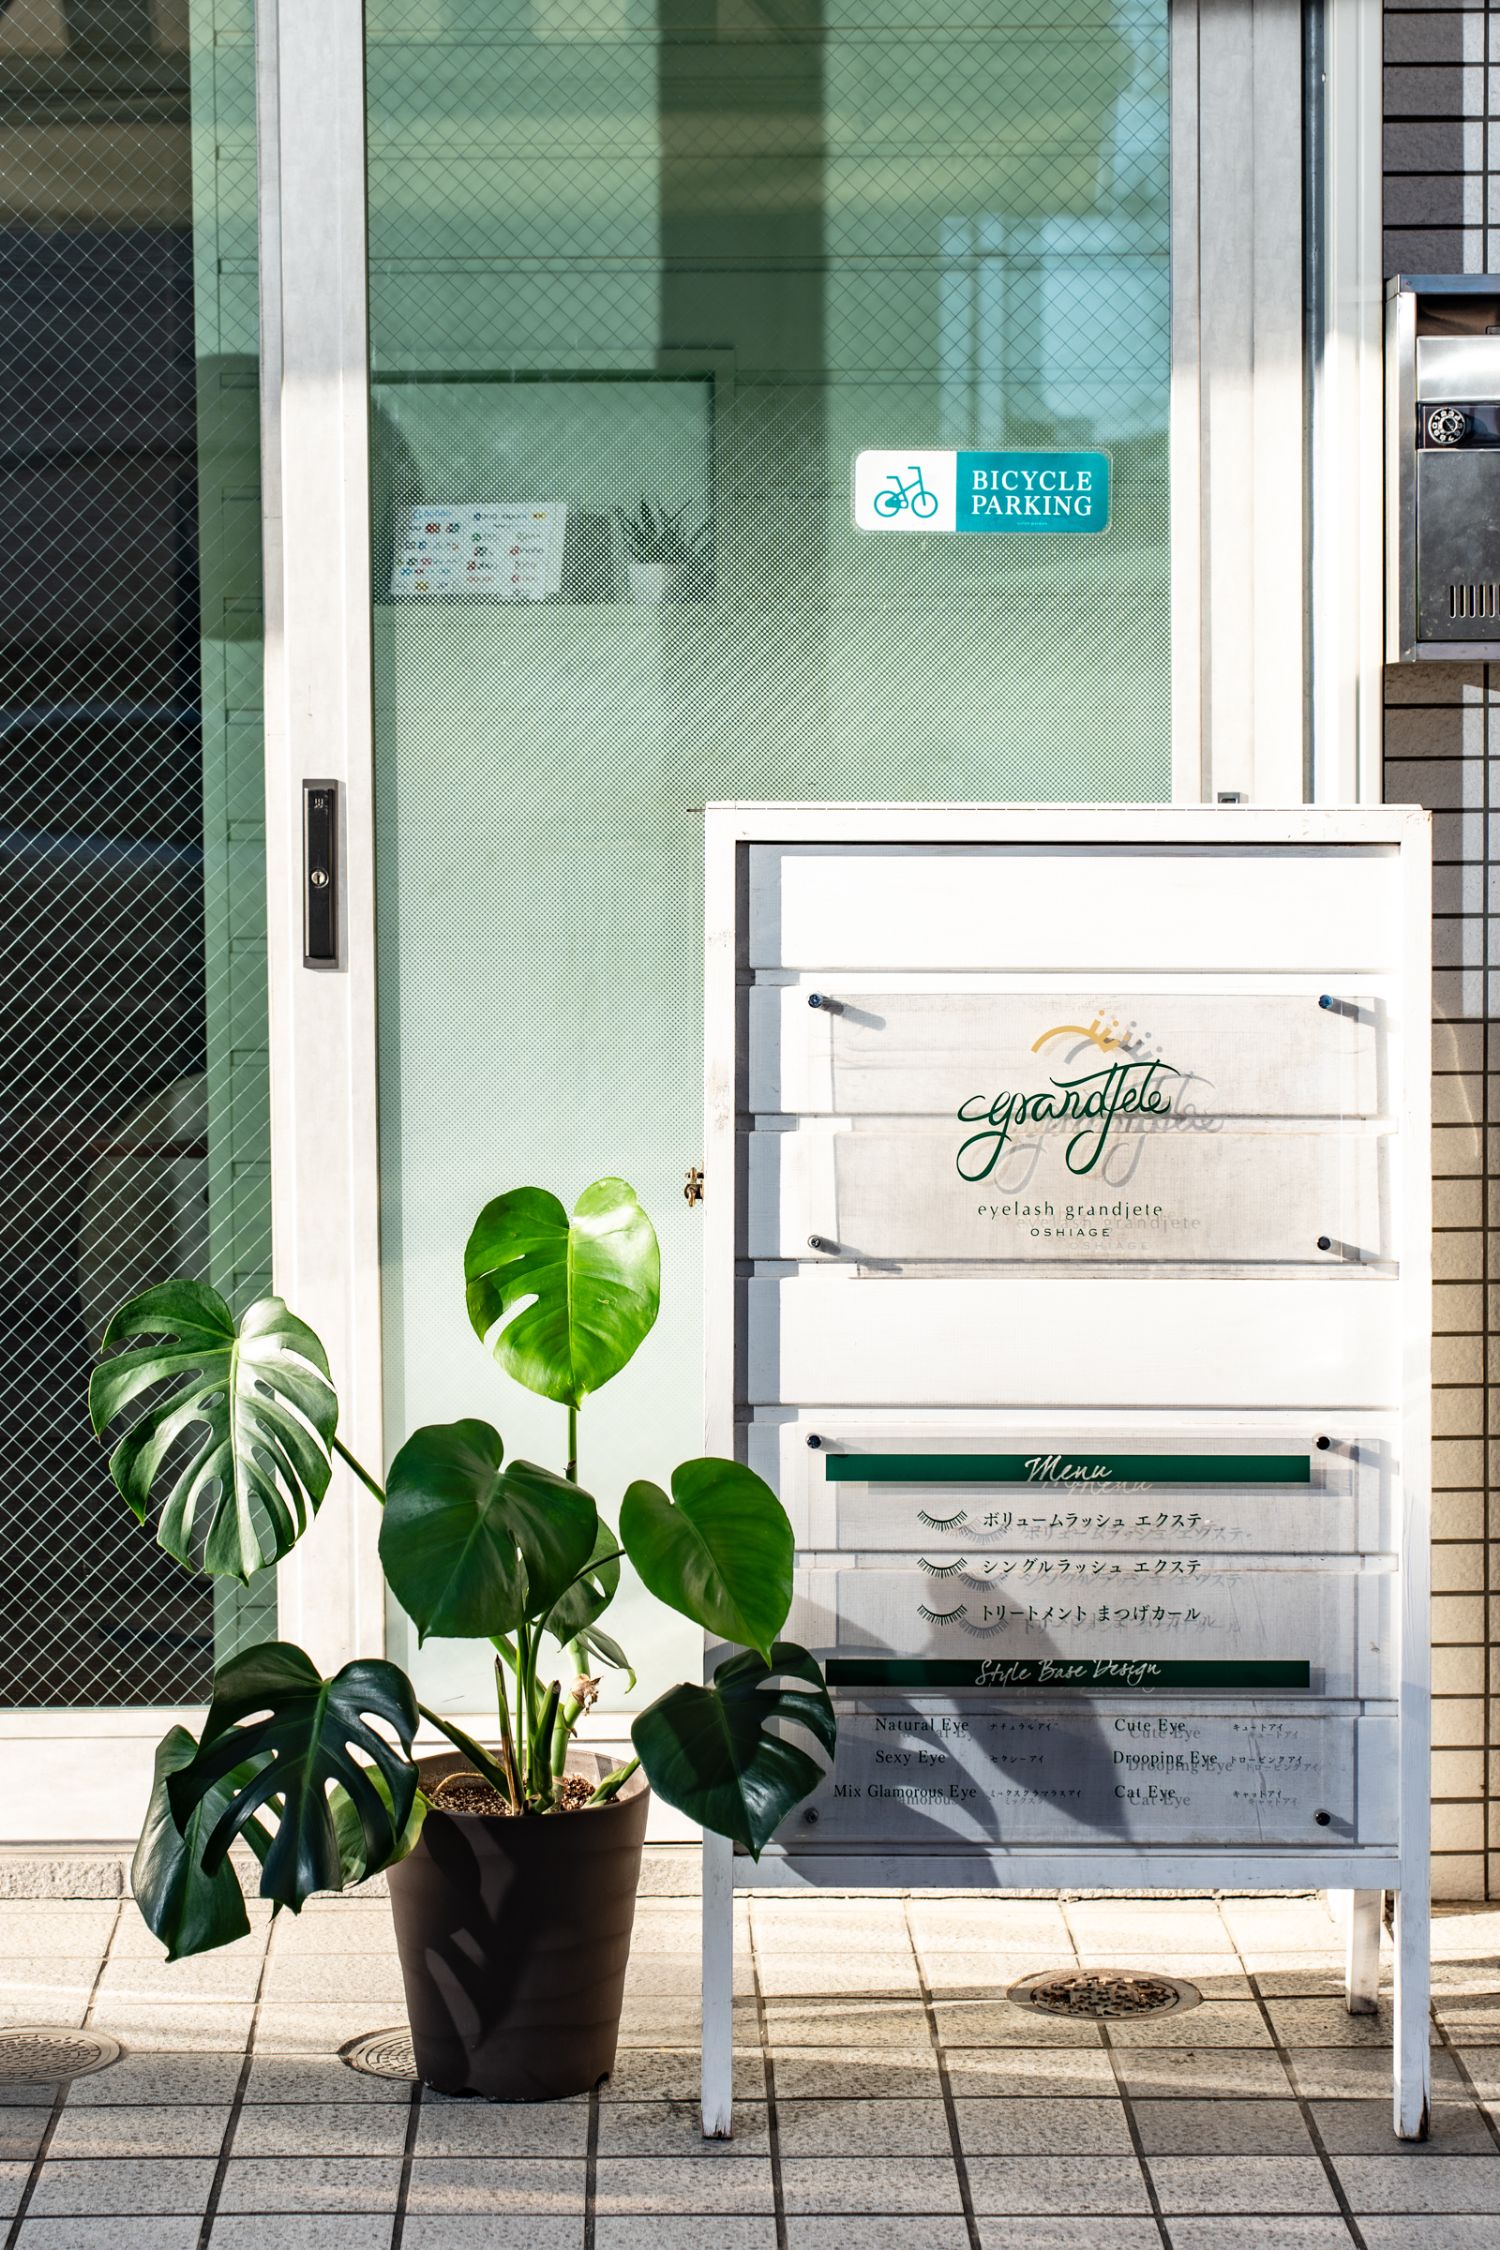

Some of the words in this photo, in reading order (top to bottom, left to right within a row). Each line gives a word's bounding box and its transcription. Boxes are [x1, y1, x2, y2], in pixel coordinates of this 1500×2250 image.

[971, 470, 1093, 491] BICYCLE
[971, 495, 1093, 516] PARKING
[977, 1201, 1055, 1221] eyelash
[1065, 1201, 1163, 1221] grandjete
[1030, 1228, 1112, 1238] OSHIAGE
[1024, 1455, 1112, 1482] Menu
[983, 1512, 1125, 1528] ボリュームラッシュ
[1135, 1512, 1202, 1528] エクステ
[983, 1558, 1122, 1574] シングルラッシュ
[1134, 1558, 1201, 1574] エクステ
[983, 1604, 1087, 1622] トリートメント
[1098, 1604, 1201, 1622] まつげカール
[975, 1659, 1032, 1687] Style
[1037, 1659, 1087, 1682] Base
[1093, 1659, 1162, 1687] Design
[874, 1718, 934, 1731] Natural
[942, 1718, 969, 1735] Eye
[1114, 1718, 1151, 1732] Cute
[1158, 1718, 1186, 1735] Eye
[874, 1750, 911, 1767] Sexy
[918, 1750, 946, 1767] Eye
[1113, 1751, 1184, 1767] Drooping
[1190, 1751, 1218, 1767] Eye
[833, 1784, 862, 1798] Mix
[867, 1784, 944, 1798] Glamorous
[949, 1784, 977, 1800] Eye
[1114, 1785, 1141, 1798] Cat
[1148, 1785, 1176, 1801] Eye
